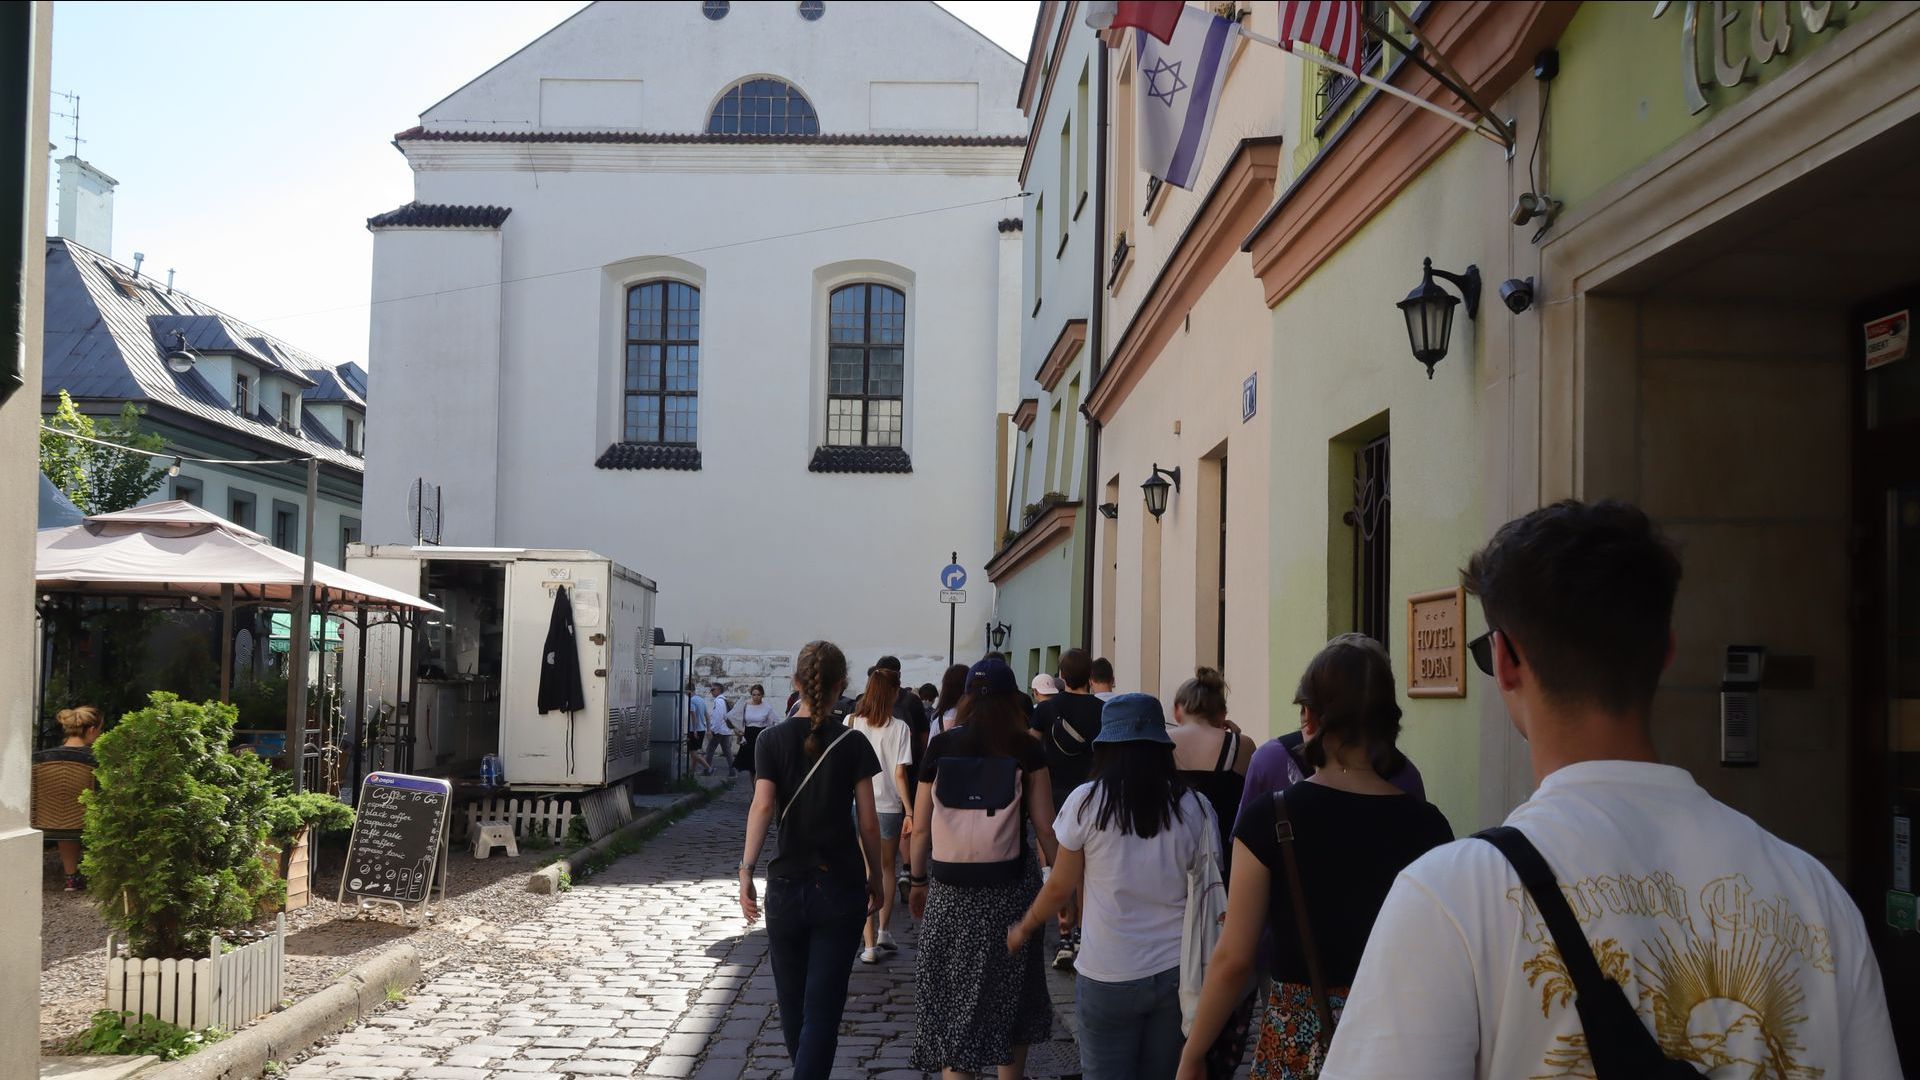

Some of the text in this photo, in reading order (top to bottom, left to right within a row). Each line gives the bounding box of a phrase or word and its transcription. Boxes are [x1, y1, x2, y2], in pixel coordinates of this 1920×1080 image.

[1417, 627, 1456, 650] HOTEL
[1421, 656, 1452, 679] EDEN
[372, 787, 438, 805] Coffee To Go
[365, 809, 388, 818] black
